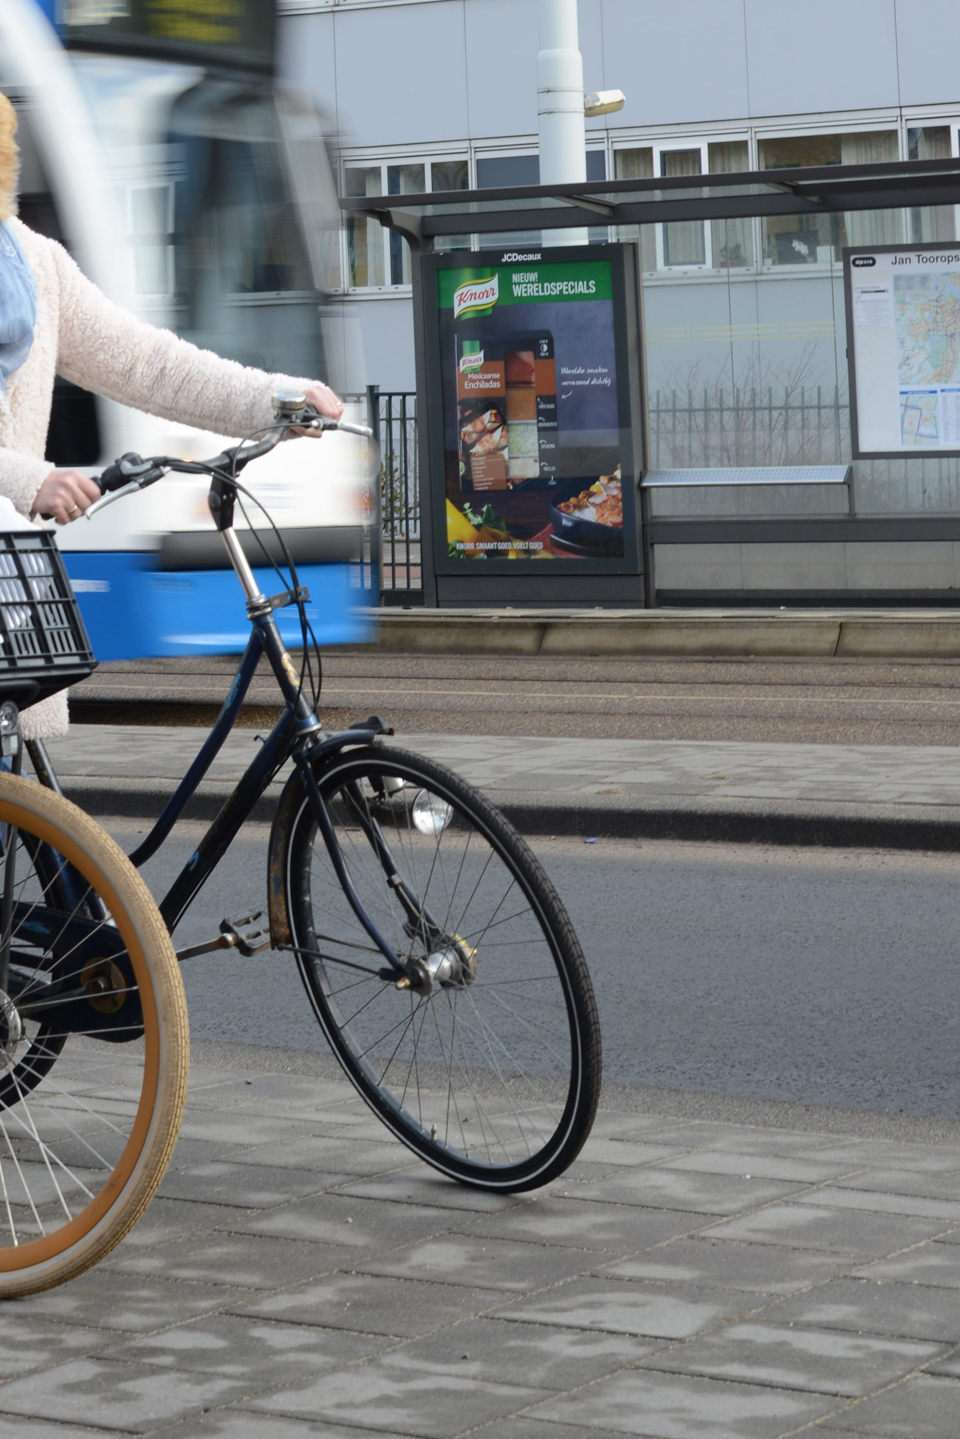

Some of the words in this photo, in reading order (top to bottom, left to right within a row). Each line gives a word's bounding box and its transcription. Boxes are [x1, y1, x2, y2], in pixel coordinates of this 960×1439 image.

[501, 252, 541, 263] JCDecaux
[891, 255, 912, 266] Jan
[915, 253, 960, 265] Toorops
[512, 271, 538, 284] NIEUW!
[512, 280, 597, 298] WERELDSPECIALS
[456, 287, 497, 308] Knorr
[464, 380, 501, 390] Enchiladas
